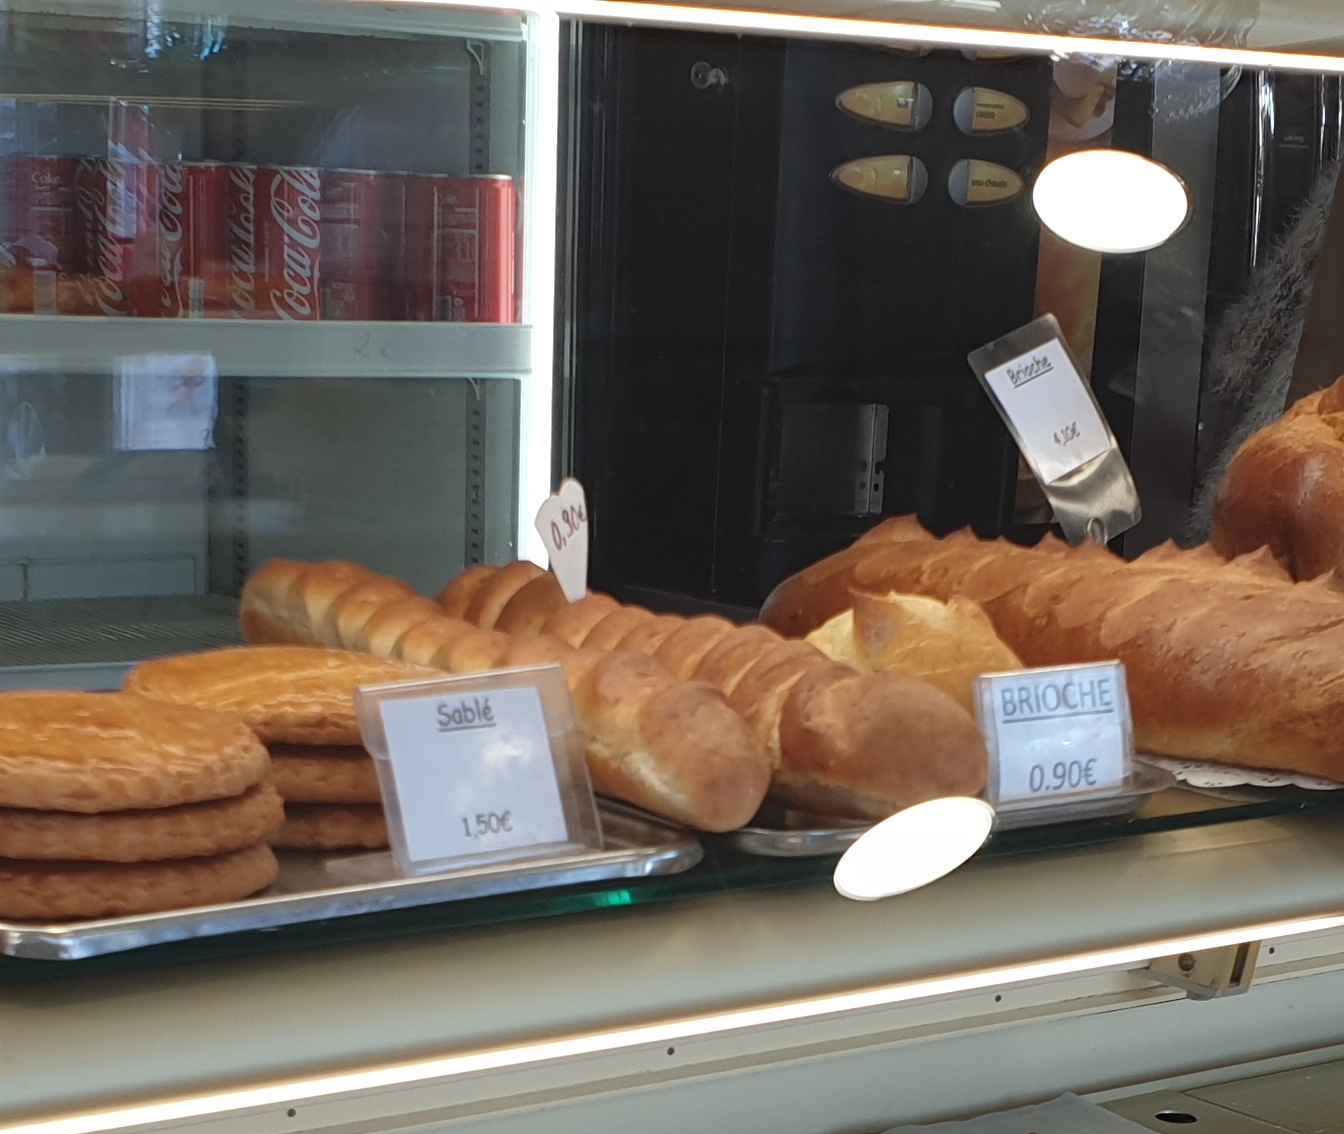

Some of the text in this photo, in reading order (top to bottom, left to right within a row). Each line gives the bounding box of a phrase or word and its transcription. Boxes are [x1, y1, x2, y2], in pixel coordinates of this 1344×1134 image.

[1007, 355, 1052, 385] Brioche
[437, 697, 494, 727] Sablé
[1001, 678, 1112, 717] BRIOCHE
[1029, 757, 1097, 793] 0.90€
[461, 810, 513, 840] 1,50€
